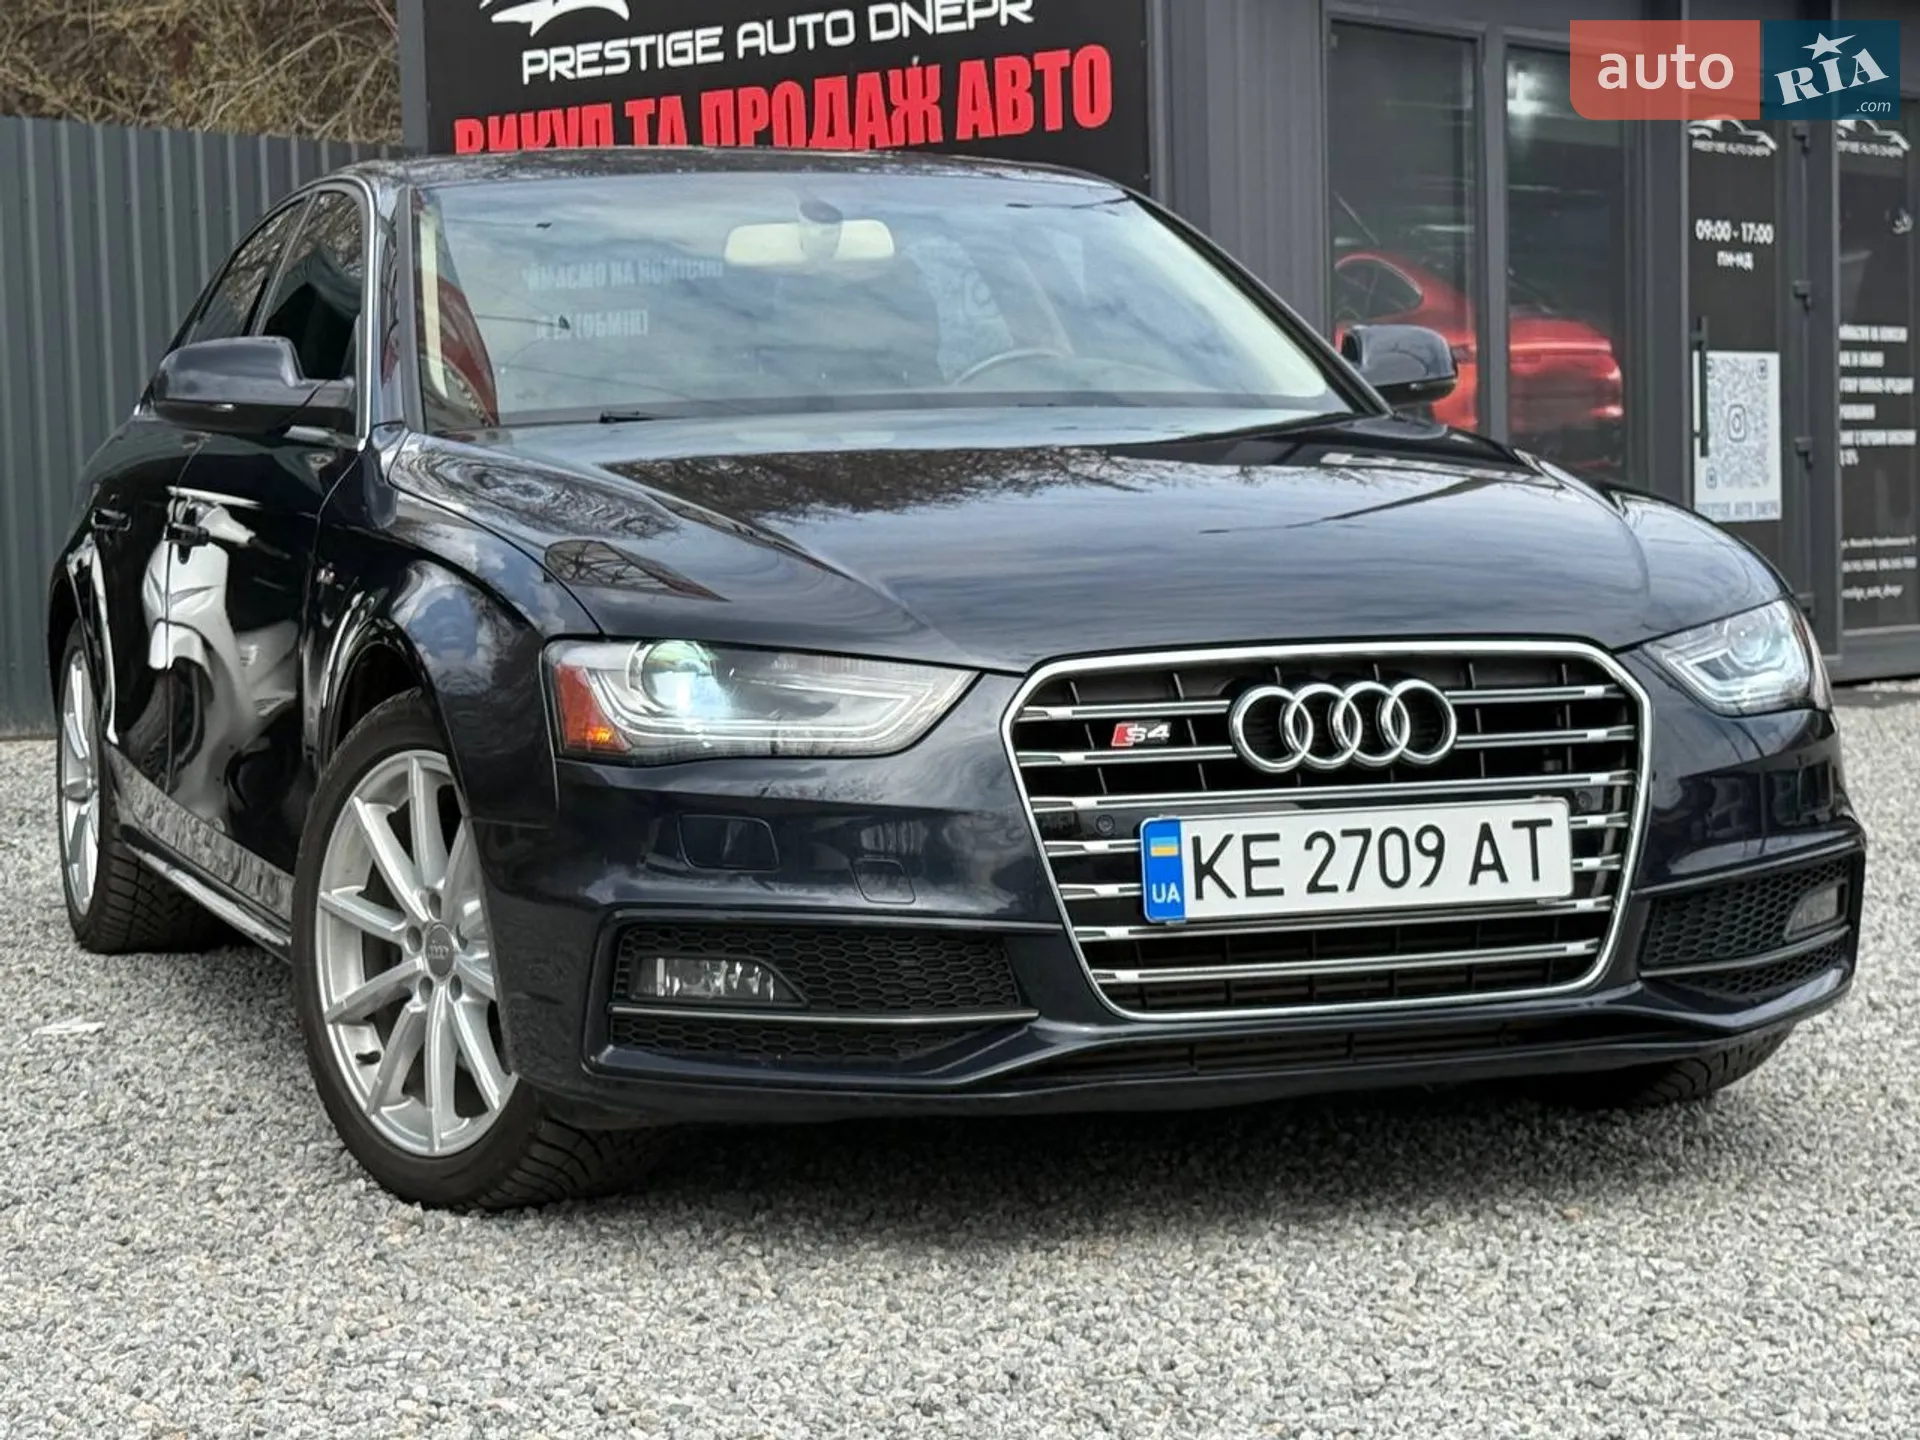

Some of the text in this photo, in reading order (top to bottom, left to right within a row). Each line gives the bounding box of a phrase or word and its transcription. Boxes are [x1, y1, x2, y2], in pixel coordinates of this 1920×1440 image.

[522, 0, 1035, 85] PRESTIGE AUTO DNEPR
[624, 96, 688, 146] ТА
[700, 64, 944, 152] ПРОДАЖ
[955, 44, 1113, 141] АВТО
[1695, 219, 1731, 242] 09:00
[1741, 222, 1774, 244] 17:00
[1121, 722, 1171, 744] S4
[1193, 818, 1553, 900] KE 2709 AT
[1152, 884, 1181, 904] UA
